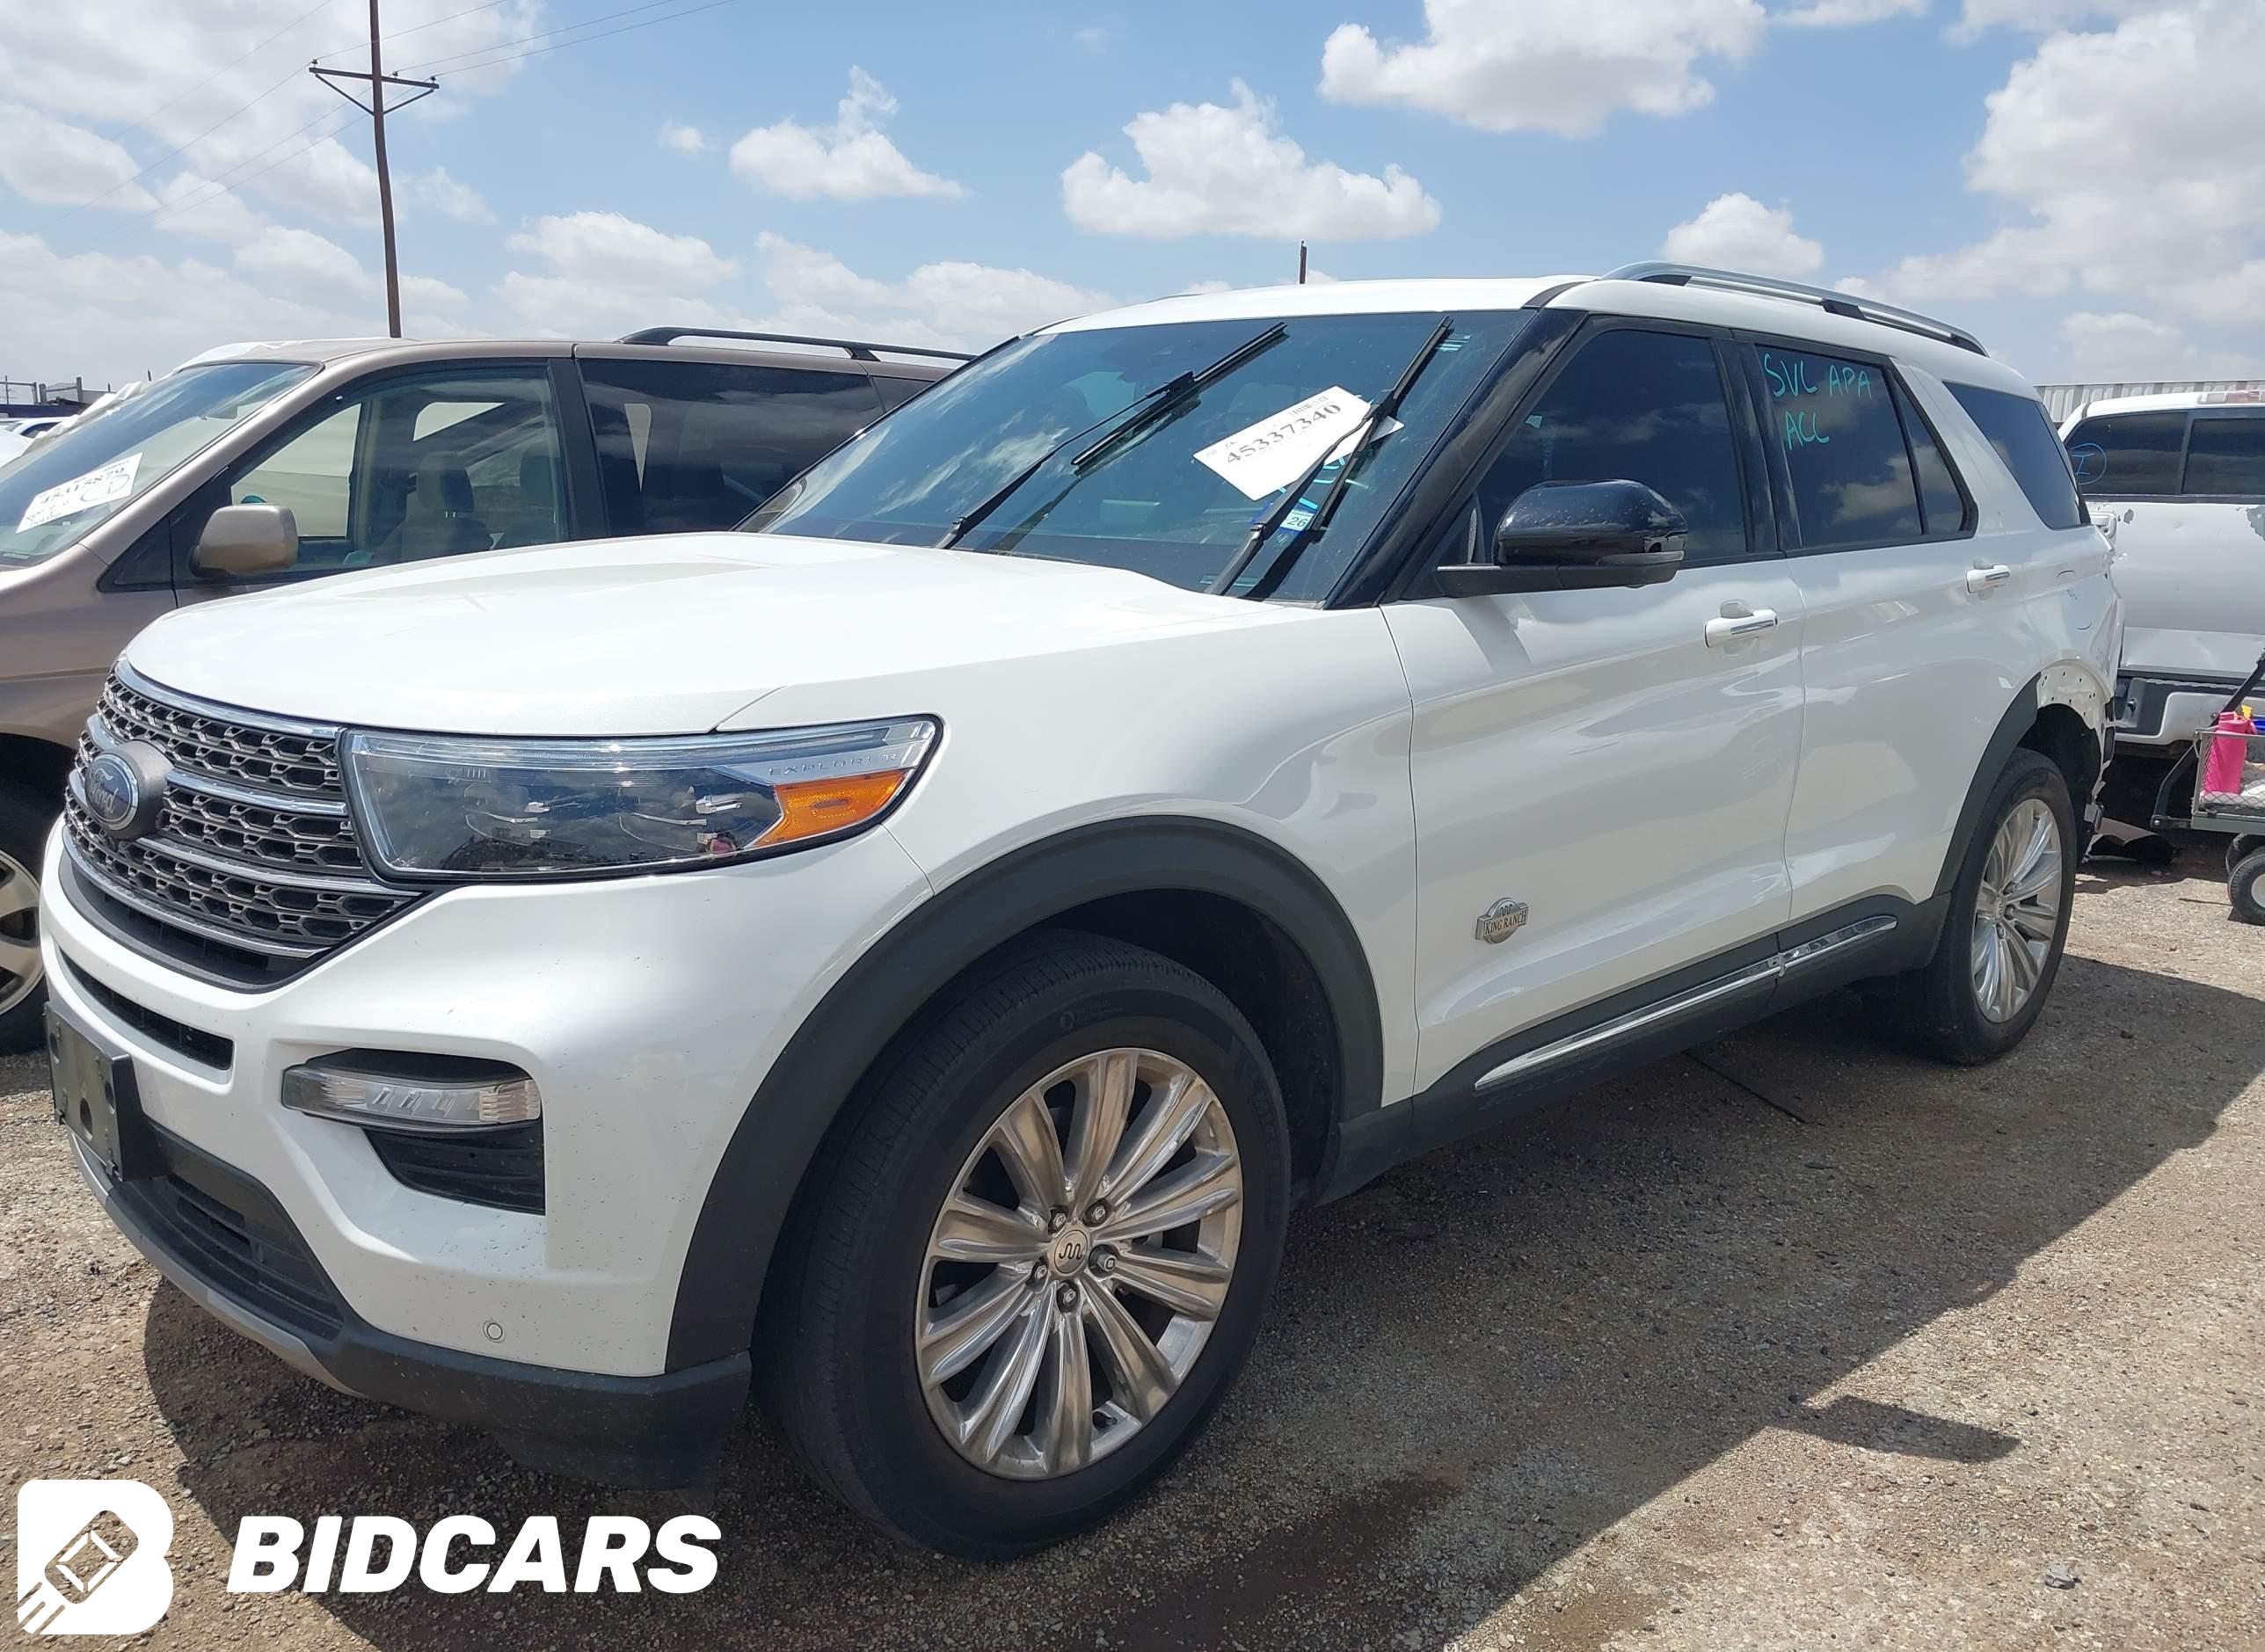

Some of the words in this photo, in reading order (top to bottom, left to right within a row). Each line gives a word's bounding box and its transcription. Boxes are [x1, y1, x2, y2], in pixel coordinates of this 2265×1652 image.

[1829, 365, 1872, 400] APA
[1227, 404, 1341, 464] 45337340
[1484, 919, 1503, 935] KING
[1503, 909, 1527, 929] RANCH
